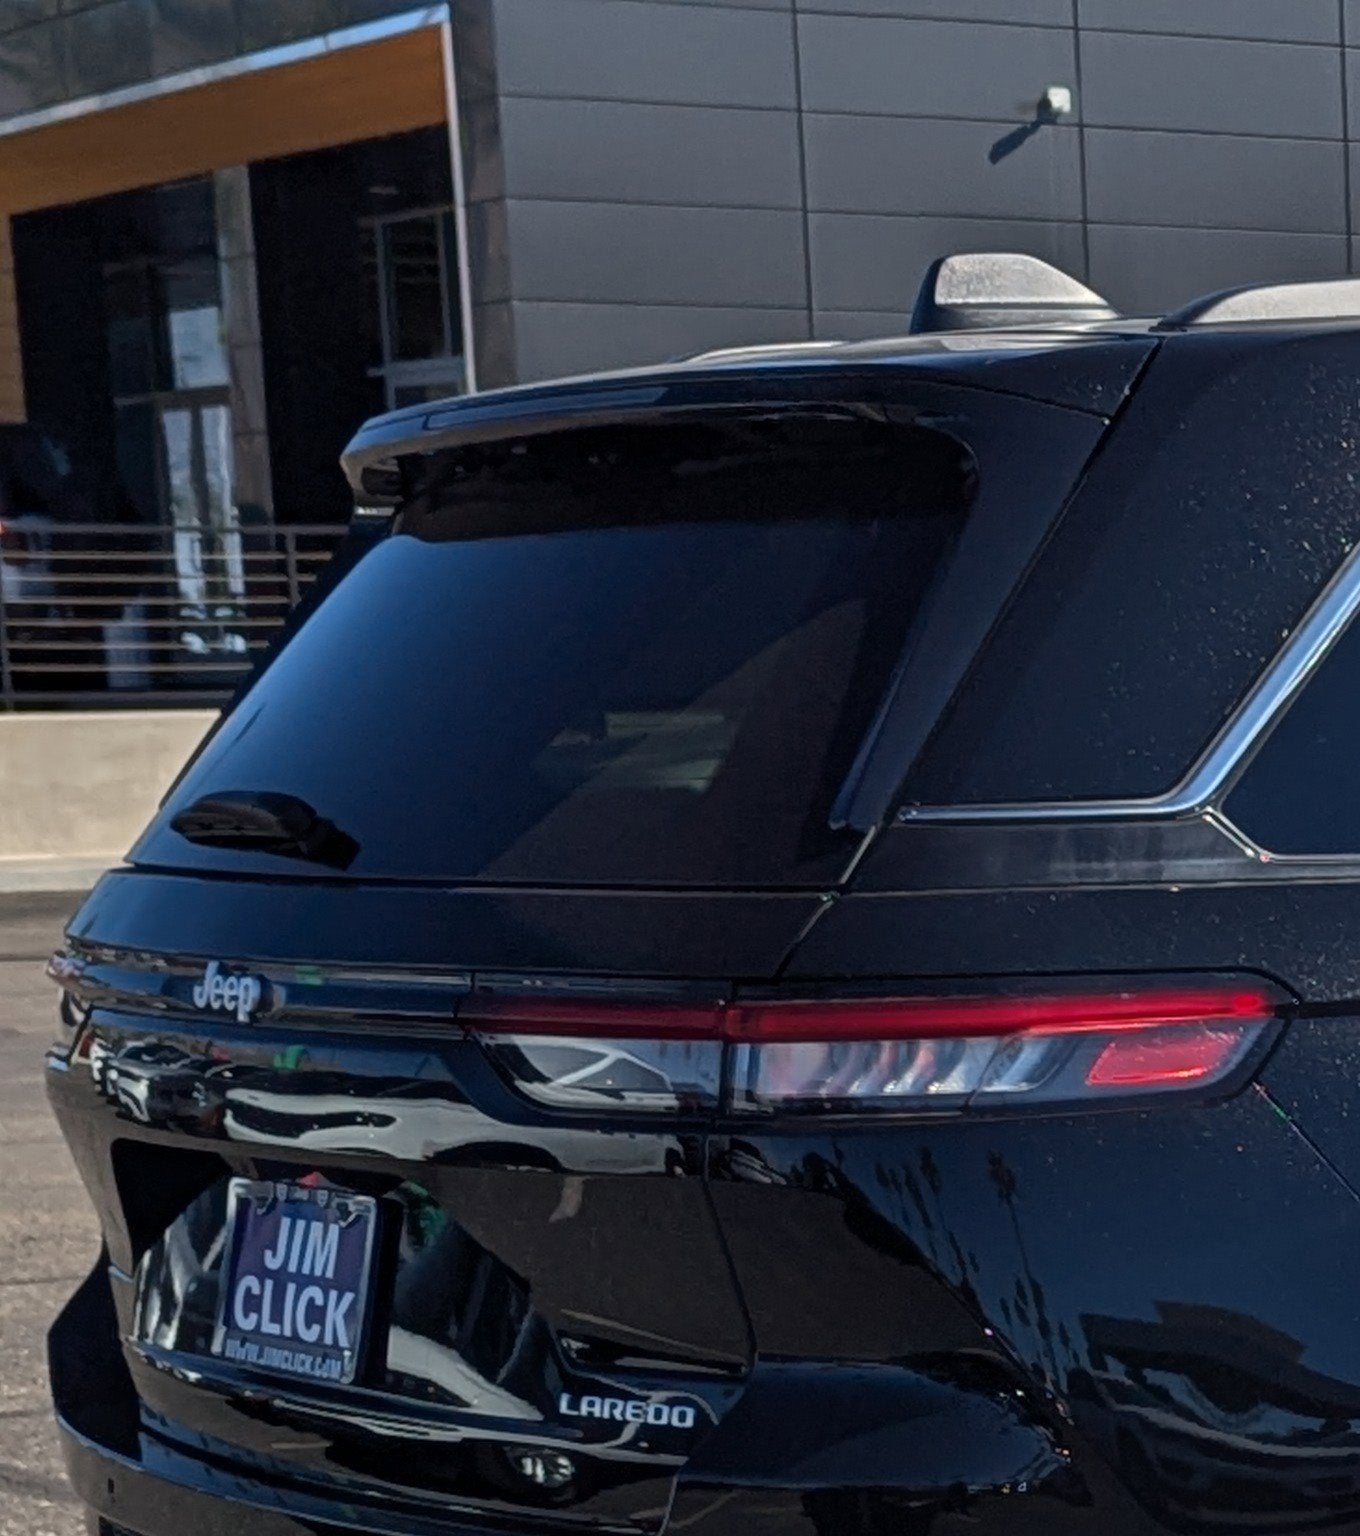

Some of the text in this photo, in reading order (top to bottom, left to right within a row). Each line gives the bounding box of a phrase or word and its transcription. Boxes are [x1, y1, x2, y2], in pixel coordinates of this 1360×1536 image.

[192, 959, 261, 1022] Jeep
[263, 1216, 340, 1280] JIM
[233, 1274, 356, 1348] CLICK
[558, 1392, 696, 1429] LAREDO
